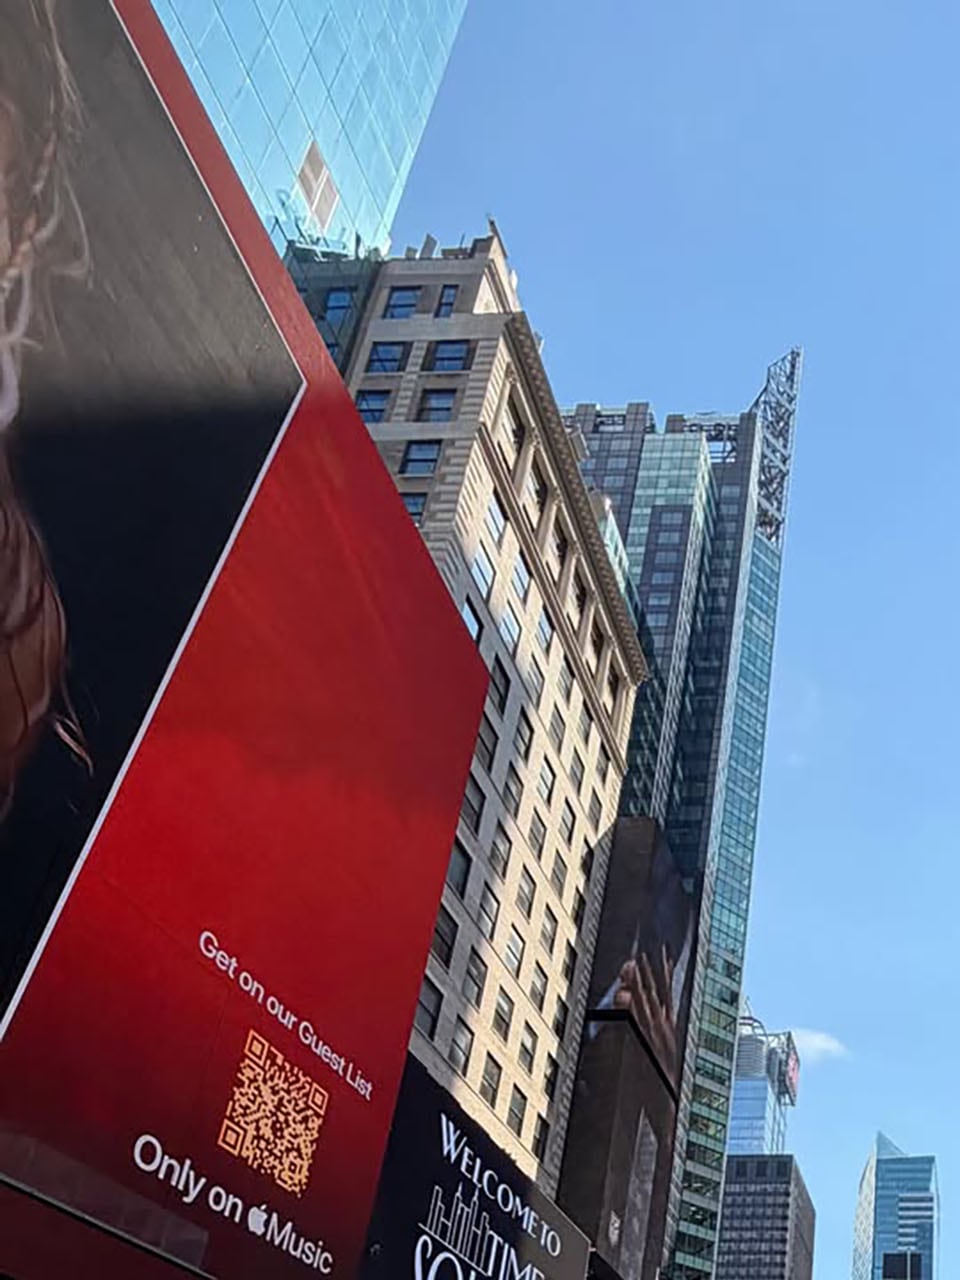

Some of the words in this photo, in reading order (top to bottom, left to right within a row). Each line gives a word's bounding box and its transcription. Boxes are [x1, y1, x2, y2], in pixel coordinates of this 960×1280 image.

[200, 931, 238, 979] Get
[239, 972, 265, 1005] on
[266, 996, 298, 1030] our
[298, 1021, 345, 1076] Guest
[345, 1063, 373, 1101] List
[133, 1134, 207, 1203] Only
[208, 1185, 243, 1223] on
[265, 1212, 333, 1274] Music
[440, 1113, 537, 1239] WELCOME
[540, 1220, 562, 1257] TO
